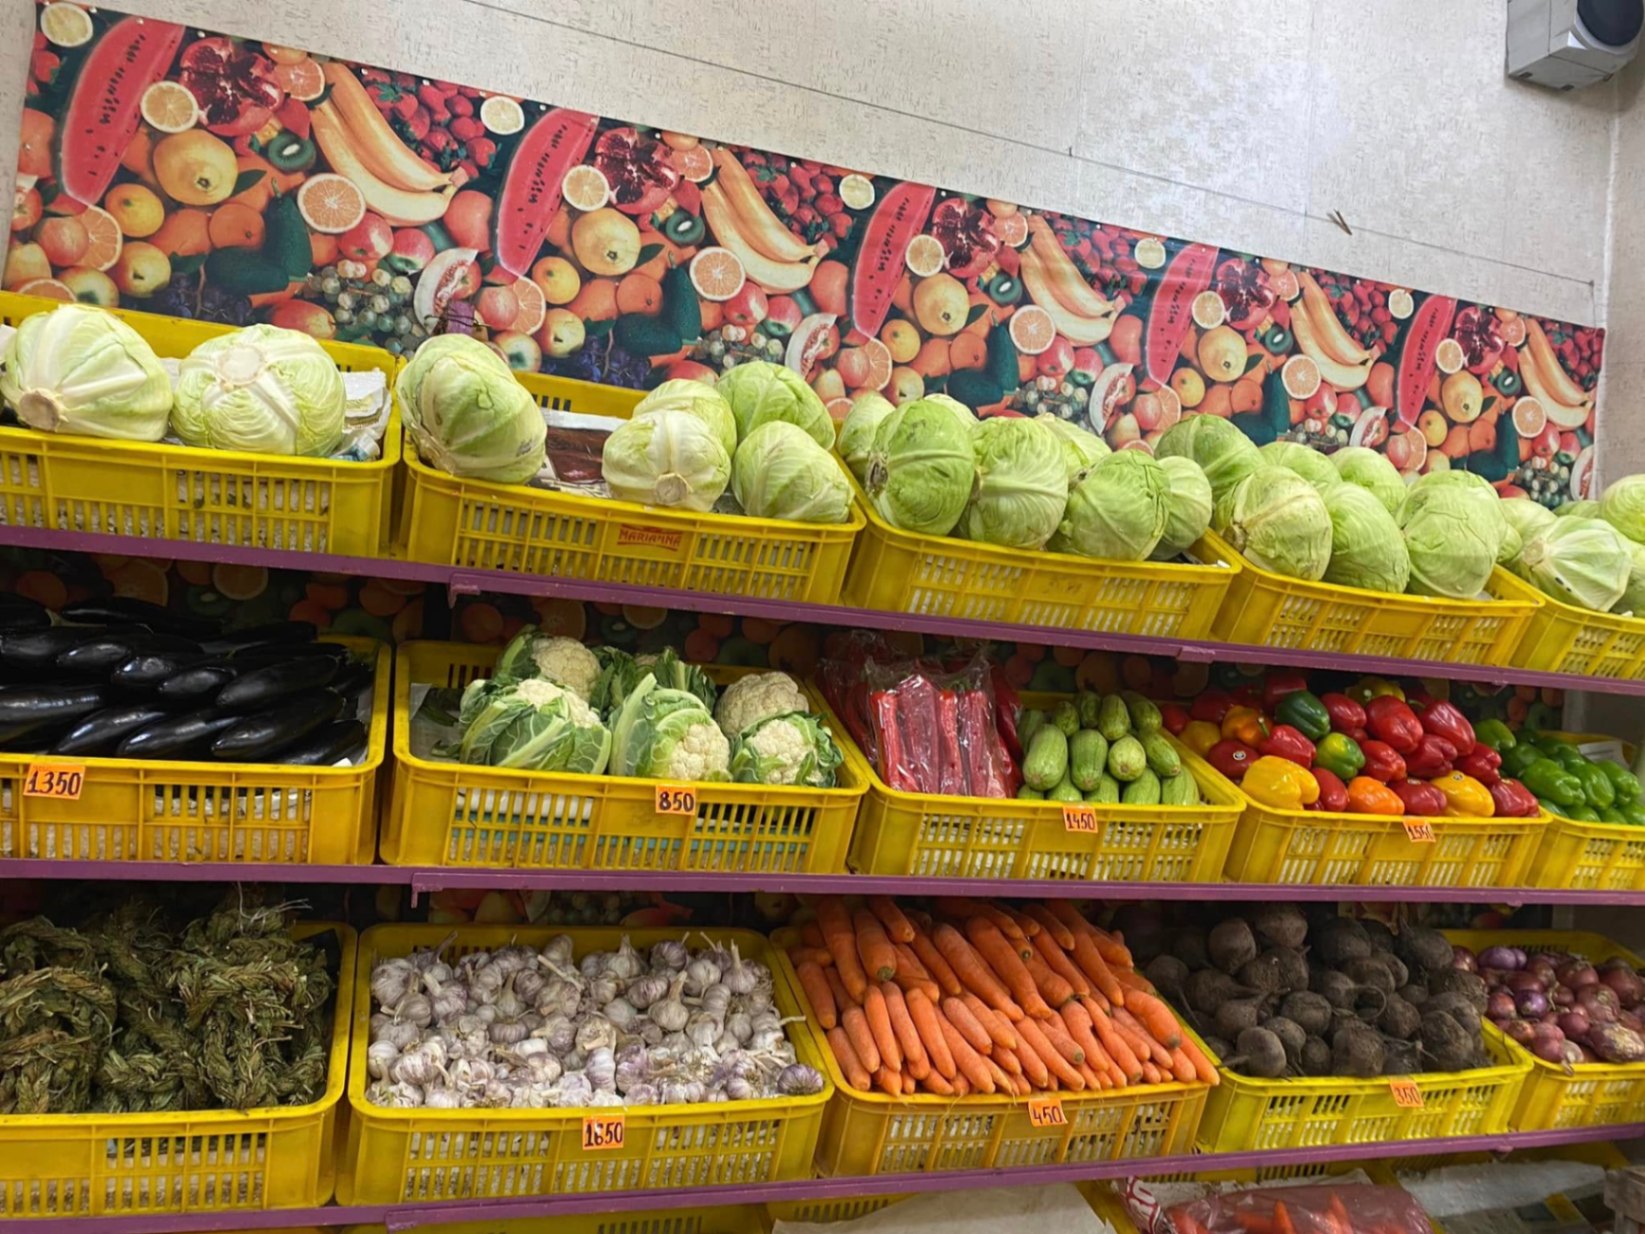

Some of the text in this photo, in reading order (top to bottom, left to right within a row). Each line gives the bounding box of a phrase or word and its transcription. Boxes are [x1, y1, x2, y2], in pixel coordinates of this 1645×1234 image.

[27, 770, 81, 796] 1350
[659, 791, 695, 812] 850
[1066, 813, 1096, 830] 1450
[1033, 1106, 1062, 1125] 450
[584, 1122, 623, 1147] 1650
